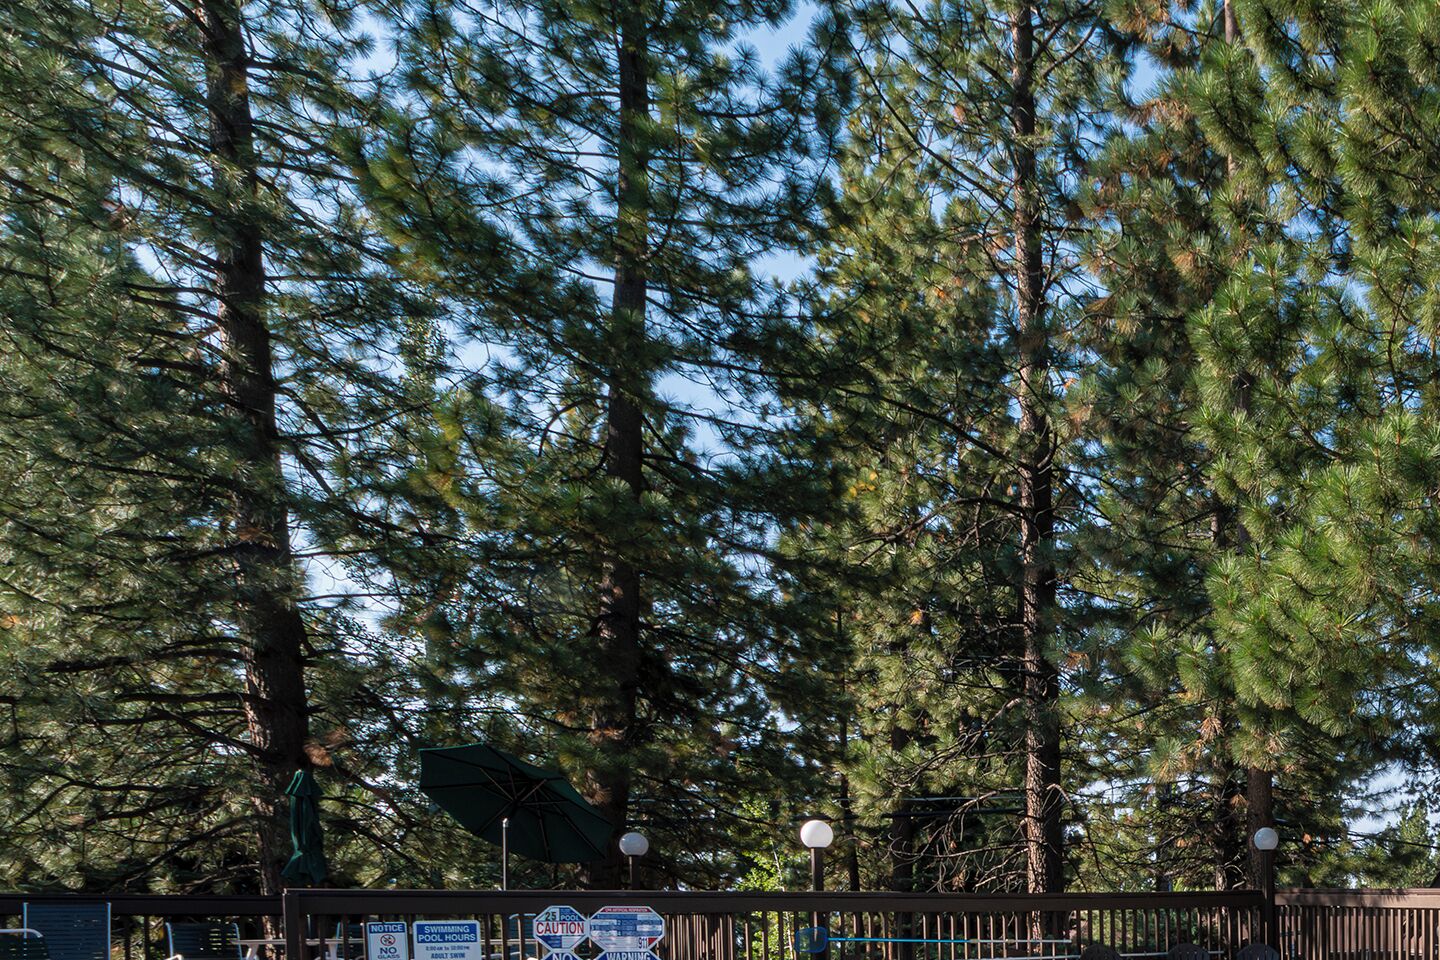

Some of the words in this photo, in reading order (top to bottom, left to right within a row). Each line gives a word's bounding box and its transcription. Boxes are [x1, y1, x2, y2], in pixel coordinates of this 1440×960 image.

[545, 912, 556, 920] 25
[536, 922, 584, 934] CAUTION
[639, 937, 647, 948] 911
